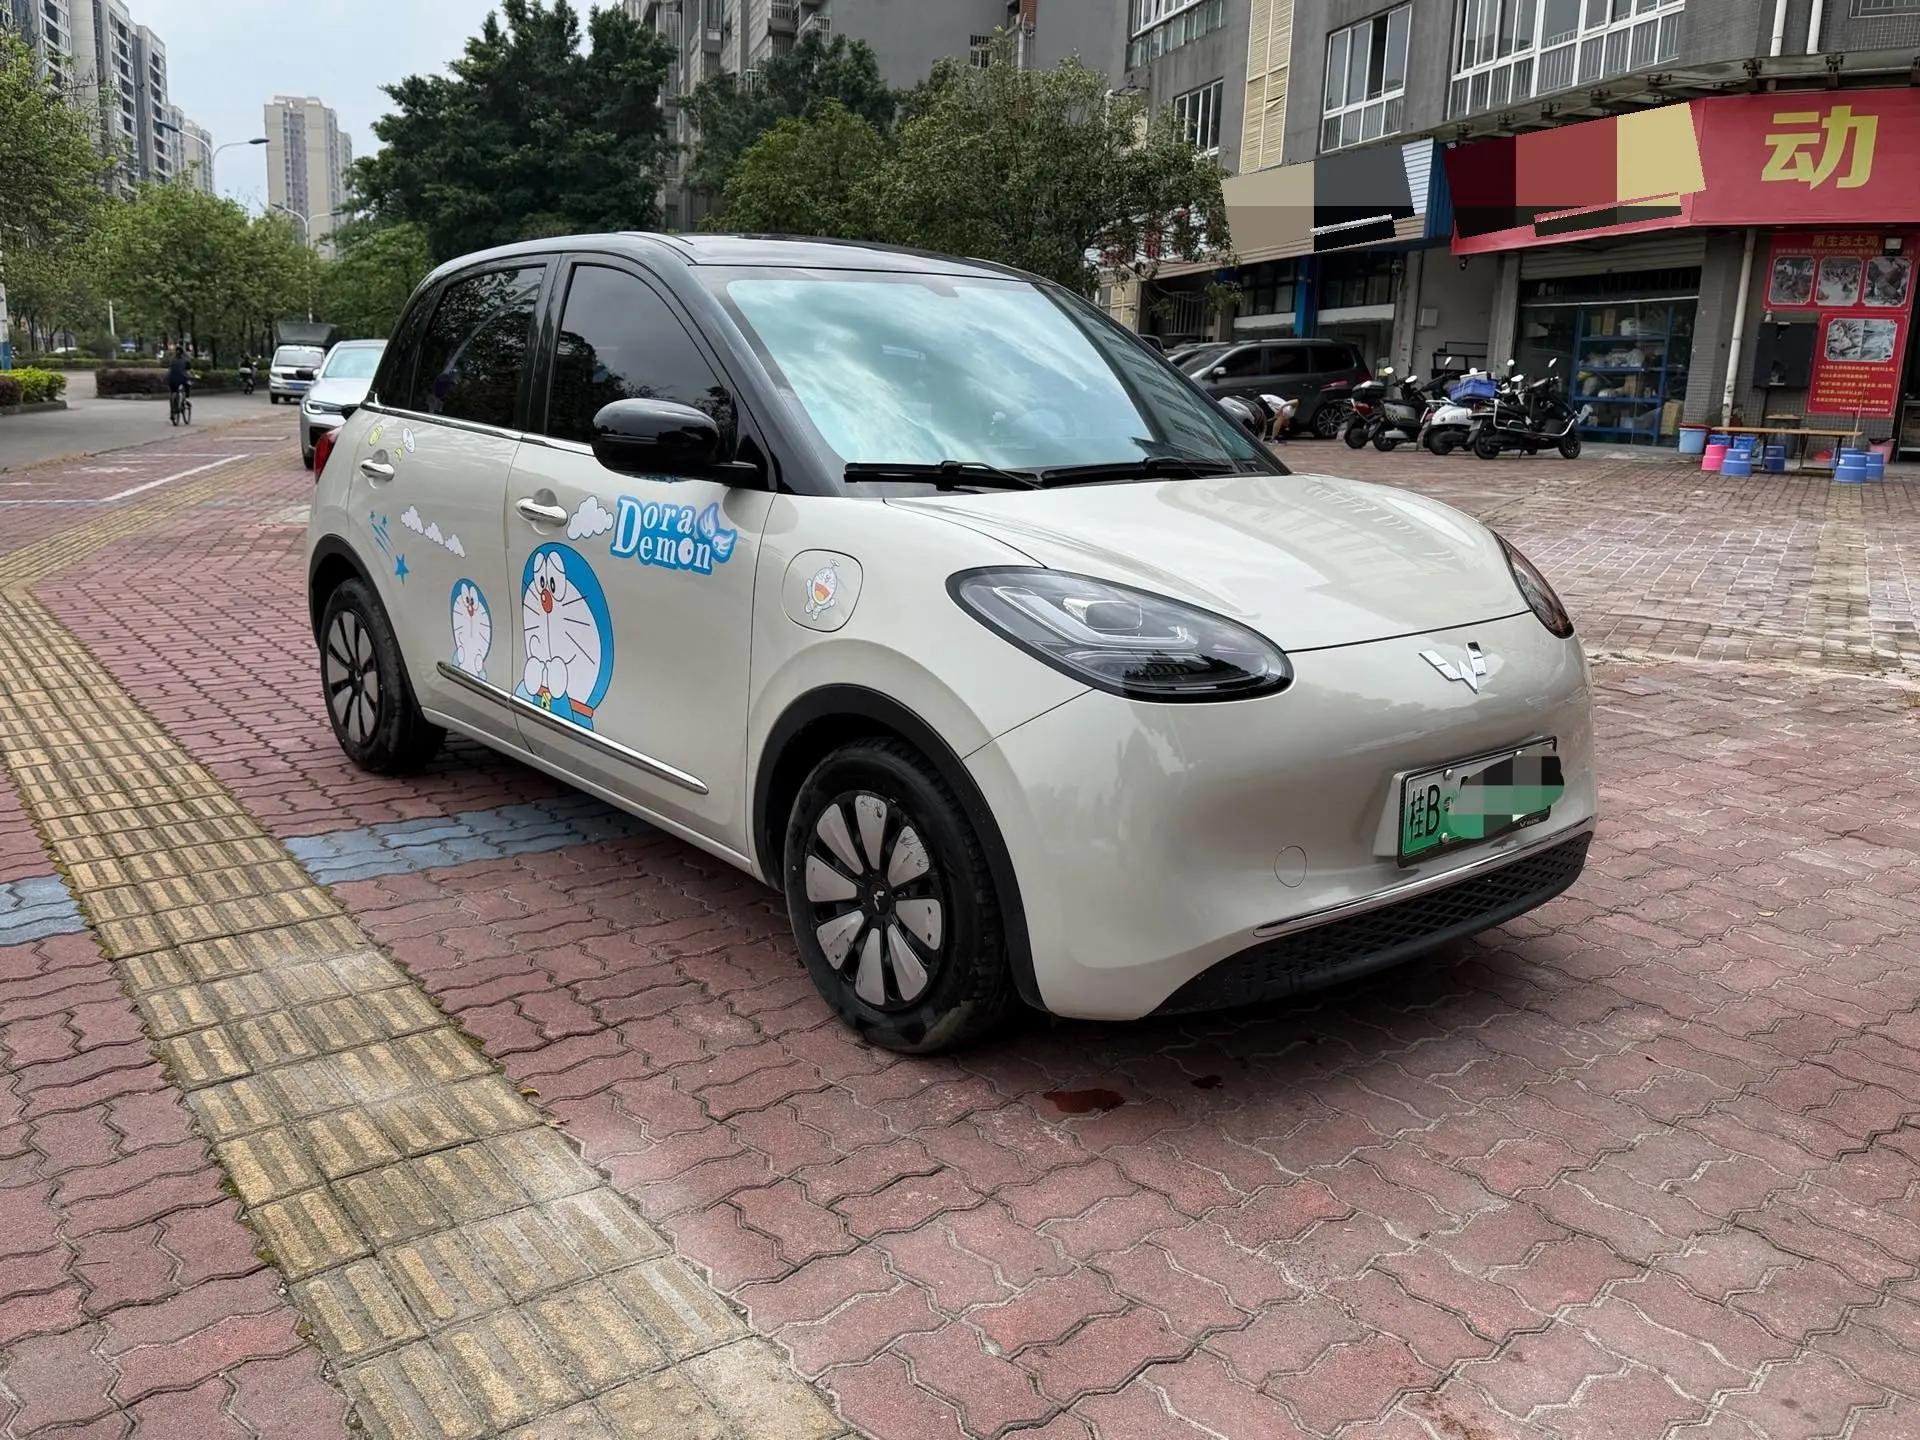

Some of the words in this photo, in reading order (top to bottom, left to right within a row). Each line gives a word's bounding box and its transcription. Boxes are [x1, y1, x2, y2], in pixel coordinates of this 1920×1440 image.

[1761, 105, 1879, 191] 动
[1812, 234, 1880, 248] 原生态土鸡
